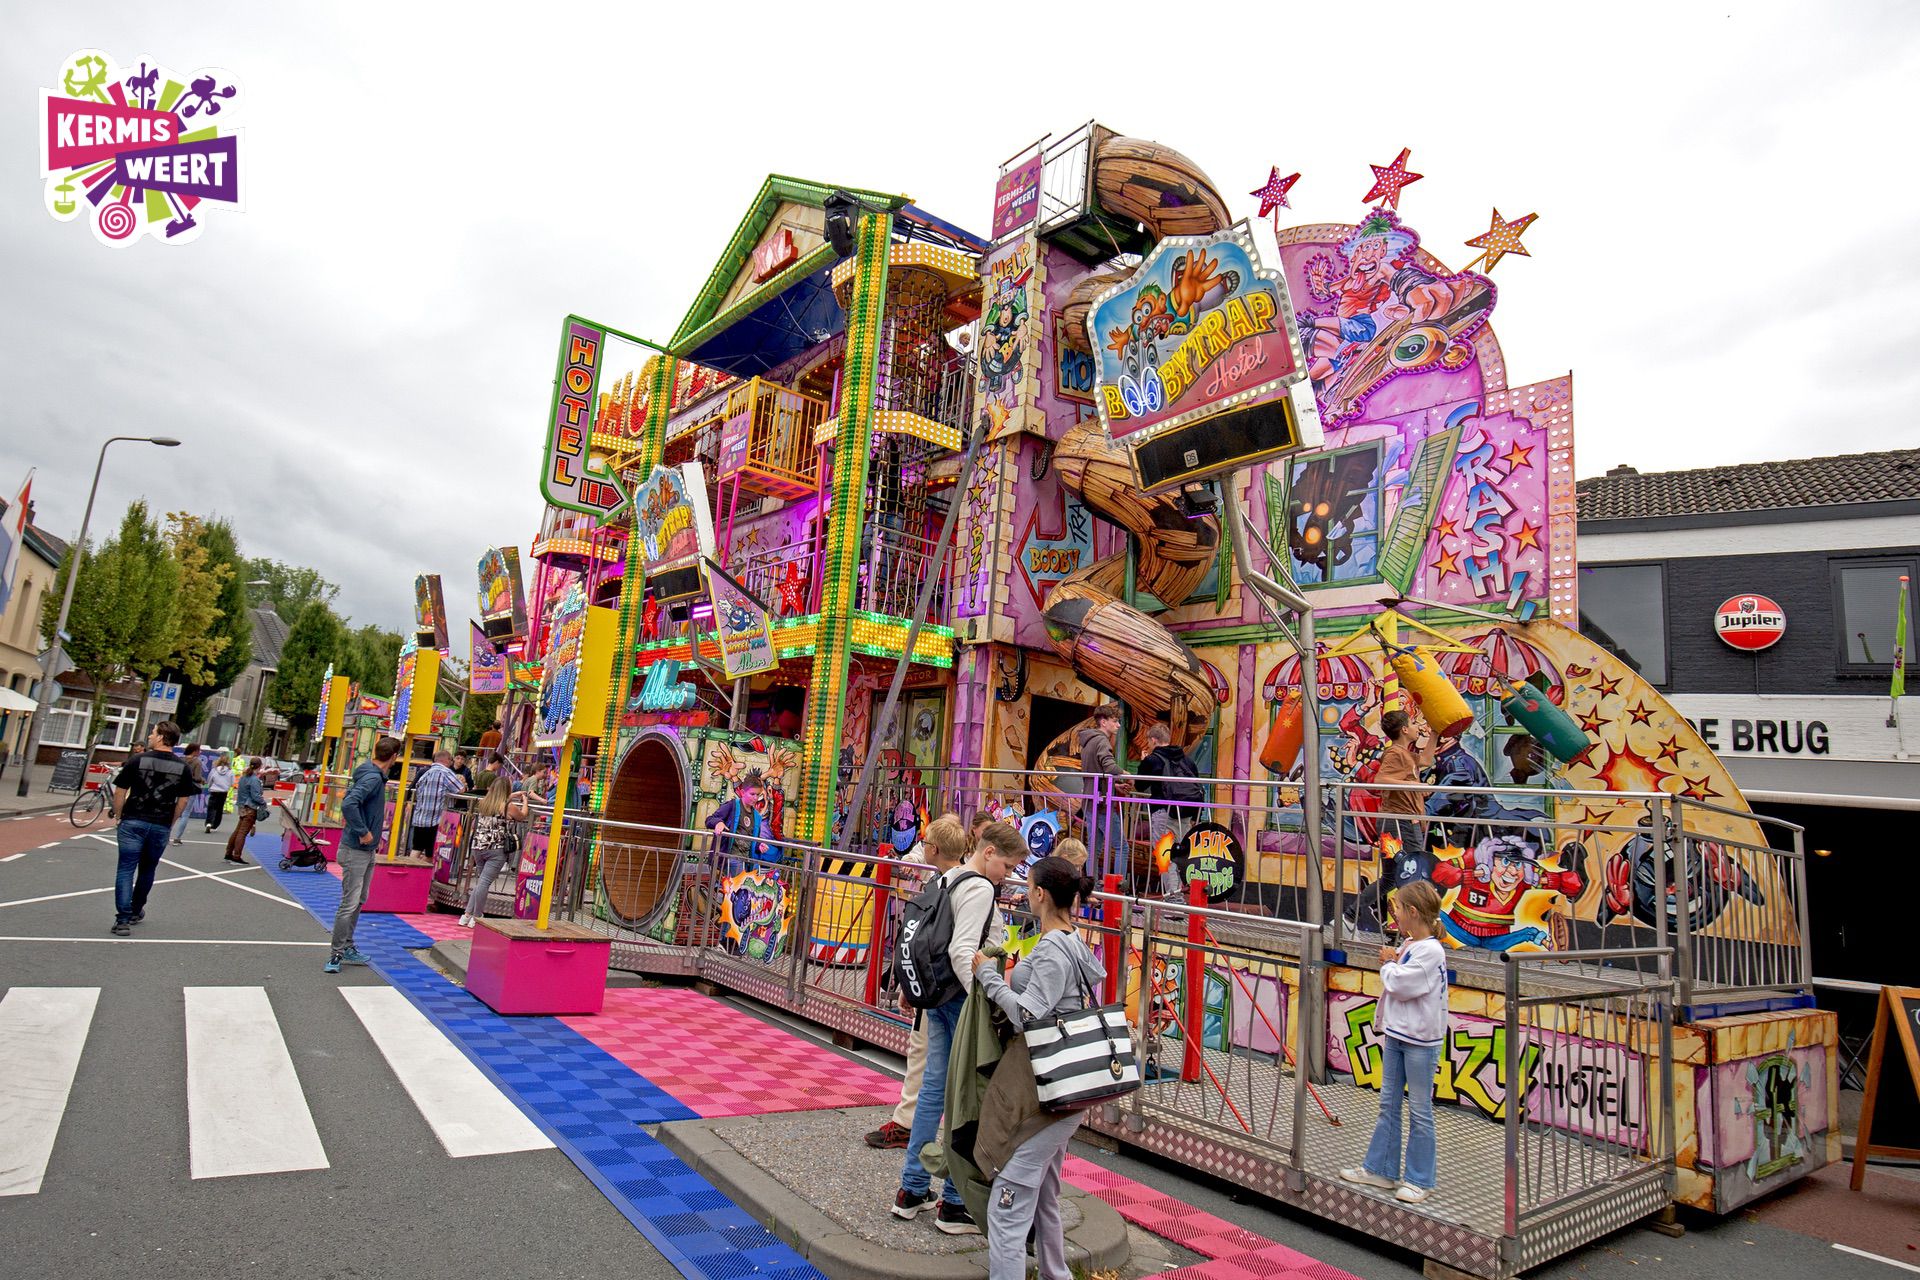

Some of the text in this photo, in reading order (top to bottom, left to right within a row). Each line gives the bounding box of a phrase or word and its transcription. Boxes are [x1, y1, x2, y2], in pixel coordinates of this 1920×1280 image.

[997, 185, 1024, 209] KERMIS
[1011, 186, 1037, 208] WEERT
[752, 229, 793, 281] XXL
[989, 242, 1031, 294] HELP
[1102, 292, 1277, 420] BOOBYTRAP
[1206, 336, 1268, 397] Hotel
[552, 334, 600, 488] HOTEL
[1068, 502, 1088, 545] TRA
[1029, 547, 1081, 575] BOOBY
[1721, 613, 1782, 629] Jupiler
[629, 659, 692, 708] Albers
[1289, 685, 1360, 697] BOBY
[1453, 675, 1502, 692] TRA
[1689, 718, 1830, 755] E BRUG
[1188, 830, 1236, 862] LEUK
[1199, 857, 1218, 871] EN
[1469, 891, 1487, 905] BT
[900, 919, 922, 997] adidas
[1342, 999, 1548, 1126] CZY
[1542, 1061, 1640, 1129] HOTEL
